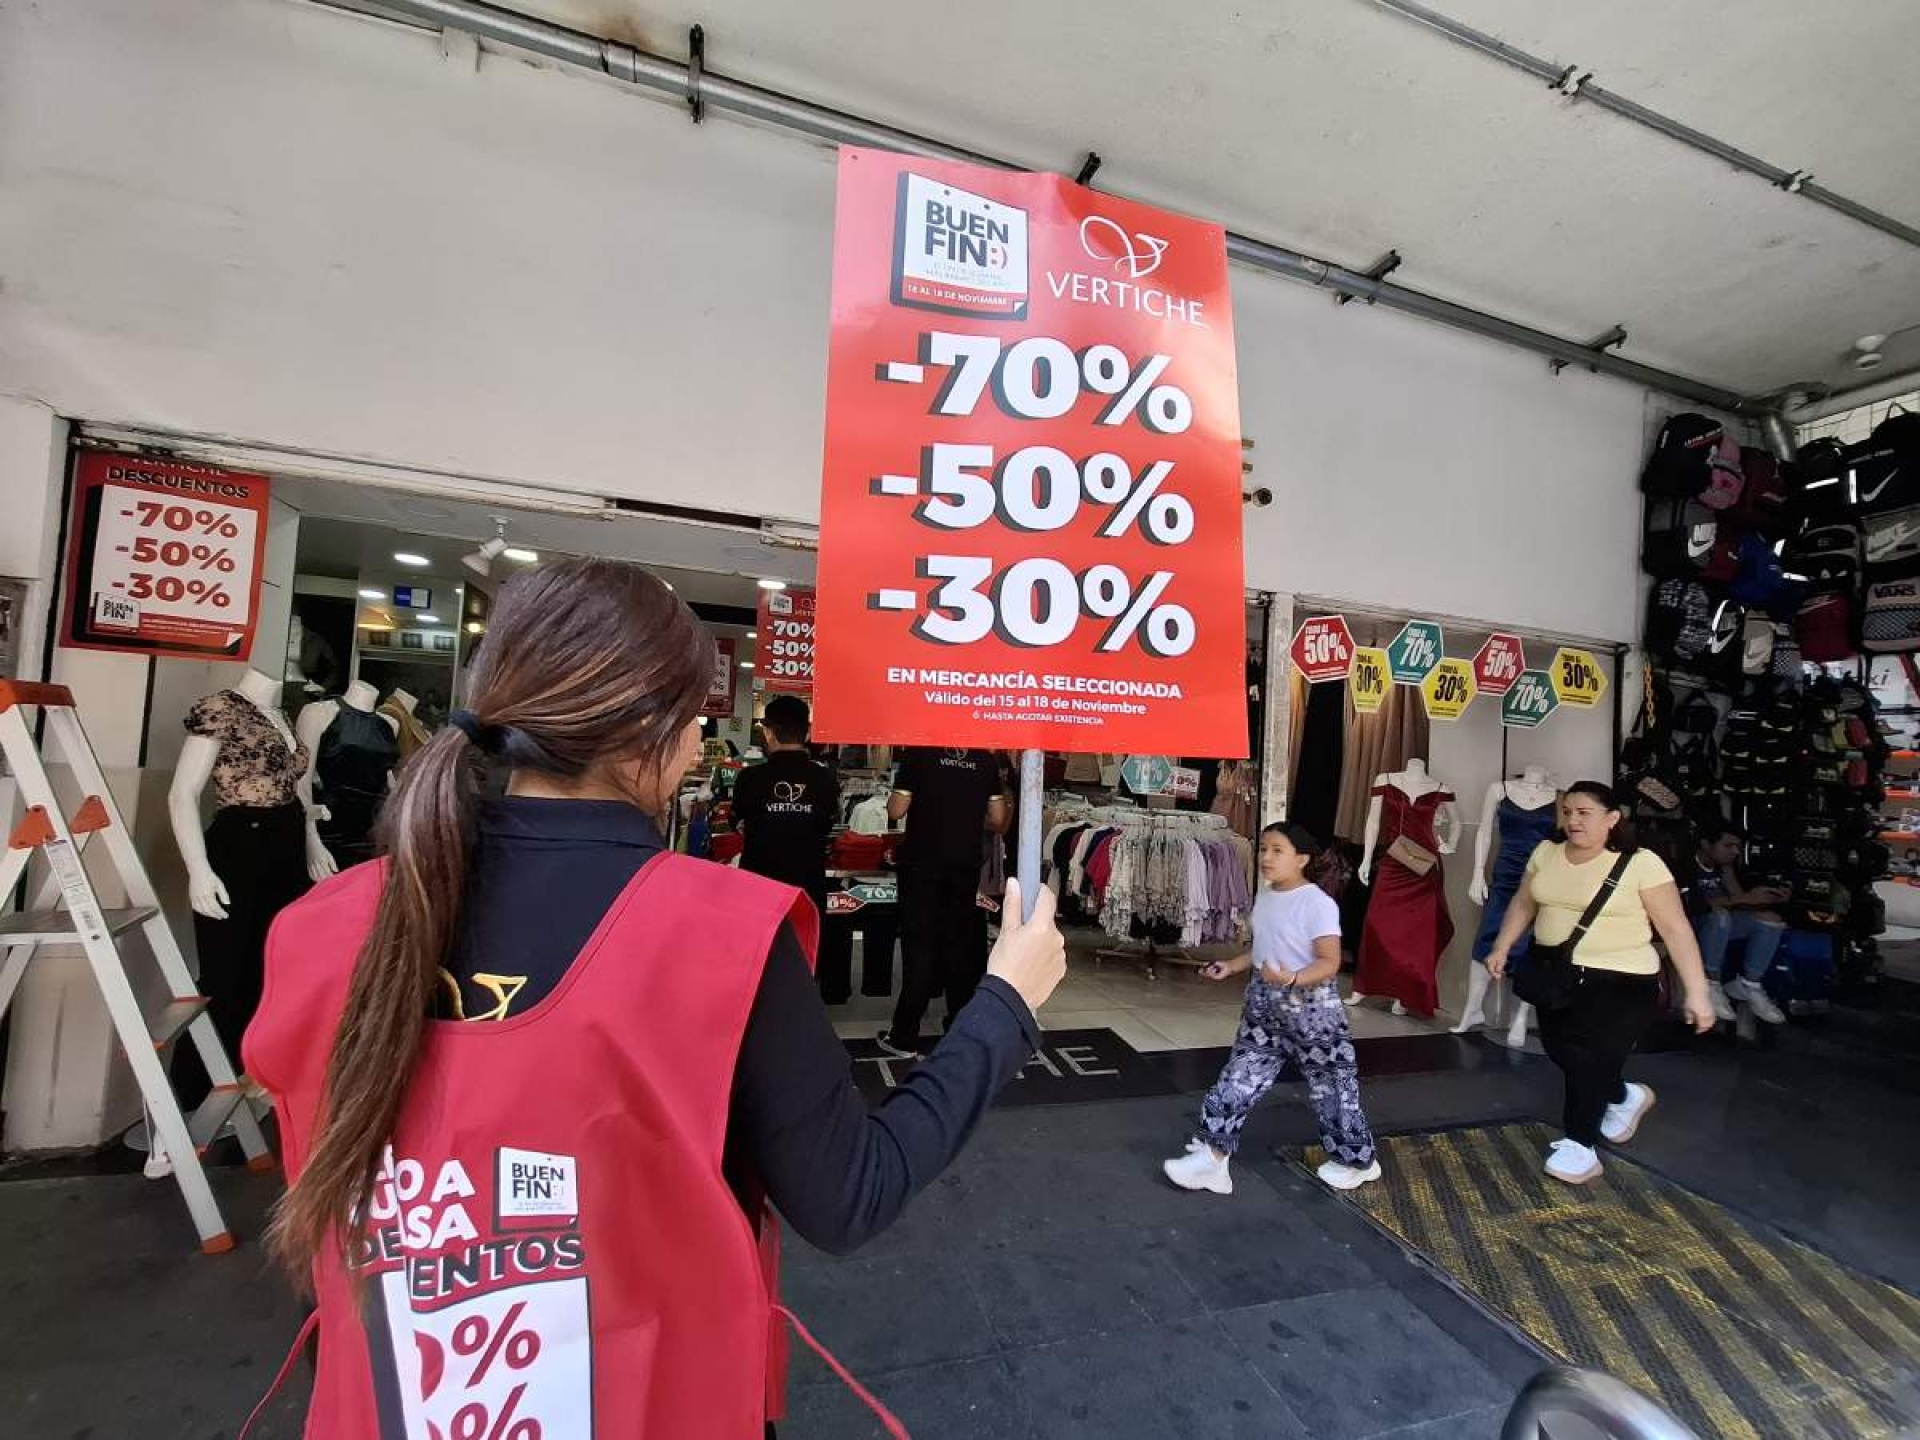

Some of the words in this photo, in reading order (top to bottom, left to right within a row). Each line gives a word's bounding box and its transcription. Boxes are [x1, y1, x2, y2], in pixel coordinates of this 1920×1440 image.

[925, 199, 1009, 244] BUEN
[1046, 271, 1205, 326] VERTICHE
[878, 331, 1193, 434] -70%
[106, 466, 250, 499] DESCUENTOS
[872, 443, 1195, 545] -50%
[120, 501, 239, 538] -70%
[115, 537, 236, 573] -50%
[111, 572, 231, 608] -30%
[1874, 585, 1917, 599] VANS
[103, 600, 134, 614] BUEN
[870, 554, 1196, 658] -30%
[1303, 631, 1348, 664] 50%
[1399, 636, 1437, 668] 70%
[1356, 663, 1383, 694] 30%
[1484, 648, 1517, 679] 50%
[1562, 661, 1599, 691] 30%
[887, 667, 915, 685] EN
[919, 669, 1038, 690] MERCANCÍA
[1042, 674, 1182, 699] SELECCIONADA
[1434, 674, 1468, 703] 30%
[1510, 684, 1549, 713] 70%
[925, 690, 970, 706] Válido
[973, 692, 996, 708] del
[998, 694, 1014, 708] 15
[1017, 694, 1031, 708] al
[1034, 695, 1049, 709] 18
[1052, 696, 1069, 710] de
[1072, 698, 1147, 715] Noviembre
[983, 711, 1014, 722] HASTA
[1054, 713, 1104, 726] EXISTENCIA
[939, 757, 977, 771] VERTICHE
[766, 803, 813, 813] VERTICHE
[511, 1162, 564, 1182] BUEN
